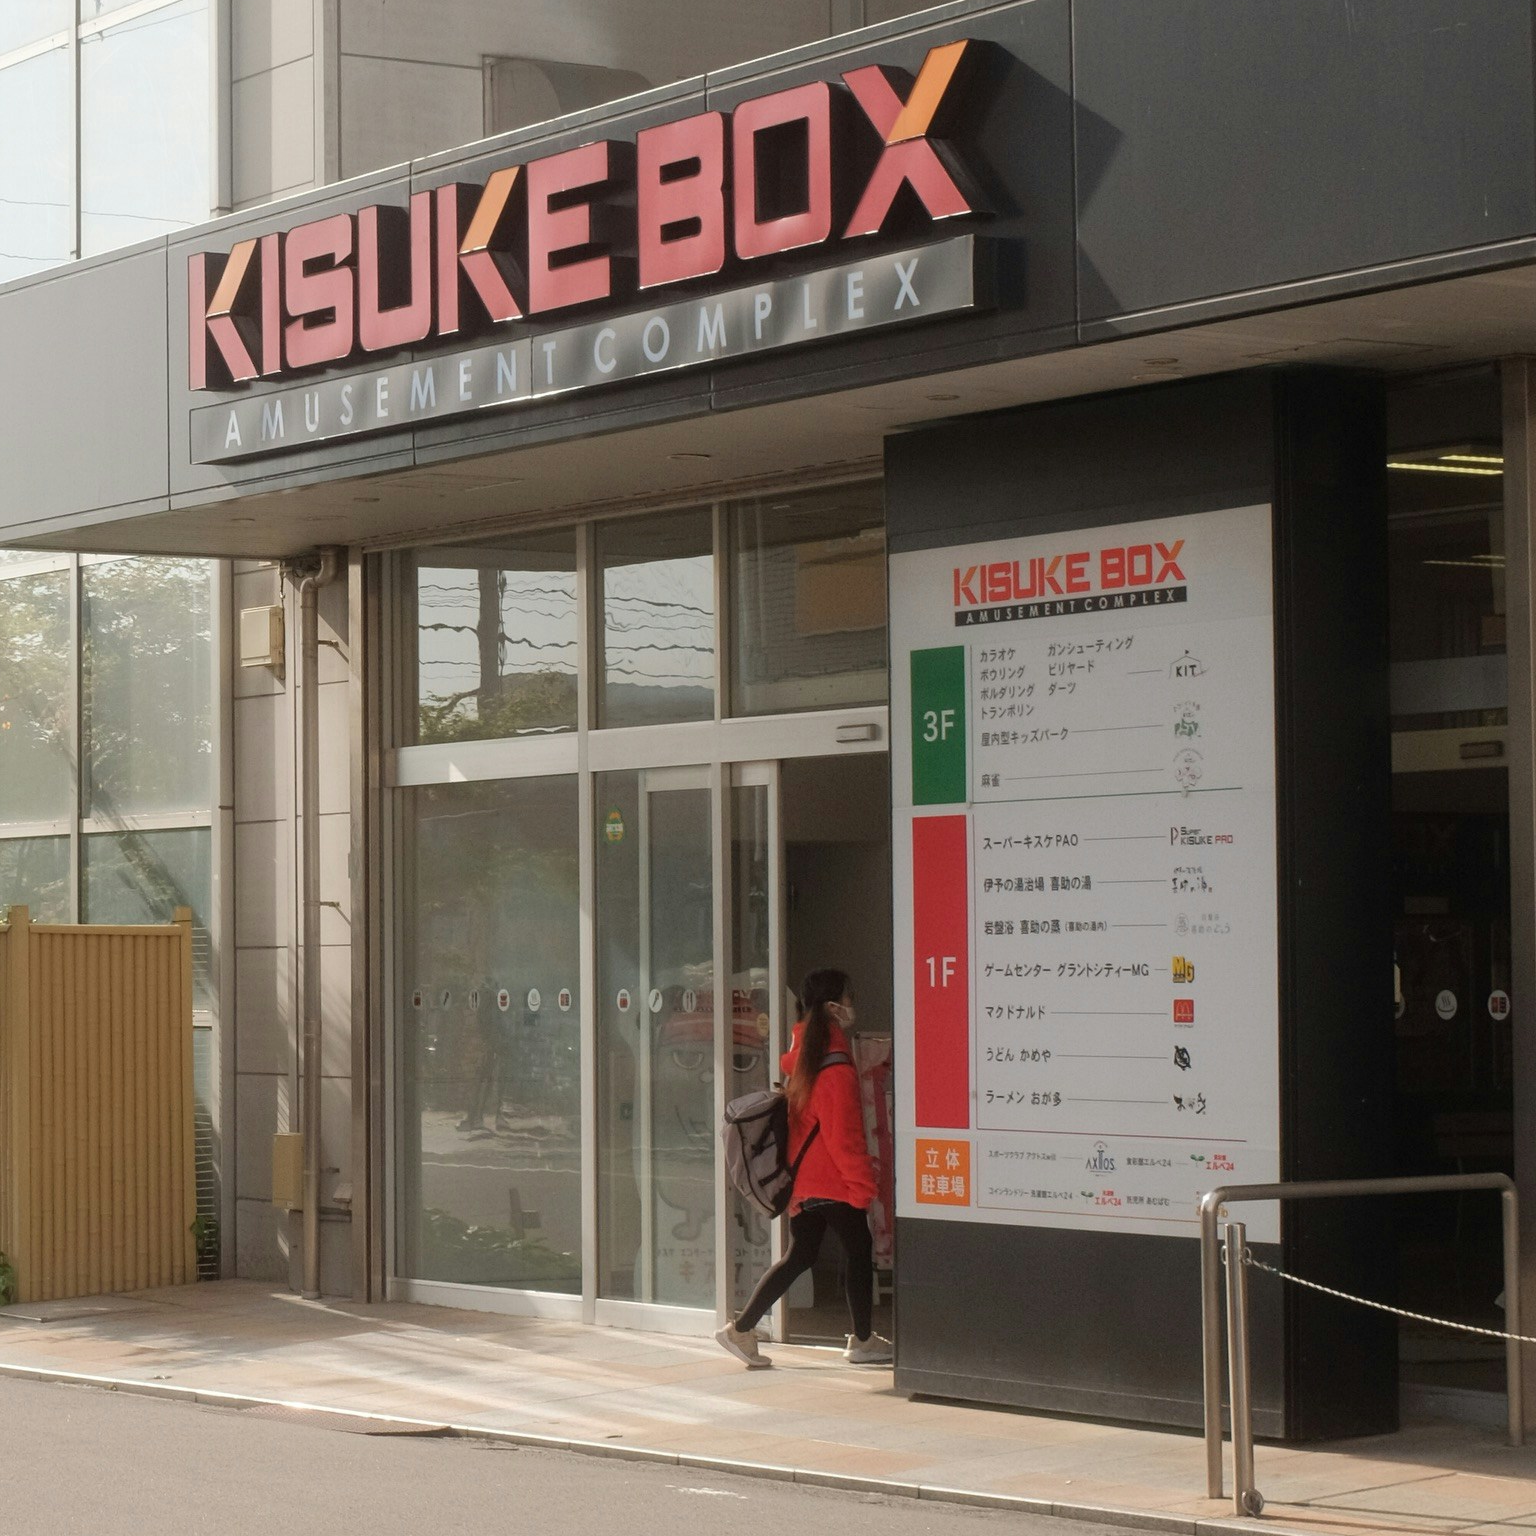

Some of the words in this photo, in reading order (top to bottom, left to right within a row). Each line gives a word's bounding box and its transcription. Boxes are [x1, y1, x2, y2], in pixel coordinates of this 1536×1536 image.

[187, 141, 611, 391] KISUKE
[636, 38, 972, 291] BOX
[225, 341, 556, 449] AMUSEMENT
[593, 258, 921, 374] COMPLEX
[953, 551, 1091, 606] KISUKE
[1100, 539, 1186, 590] BOX
[966, 602, 1075, 624] AMUSEMENT
[1084, 589, 1175, 611] COMPLEX
[980, 648, 1016, 663] カラオケ
[1047, 635, 1134, 656] ガンシューティング
[980, 666, 1026, 682] ボウリング
[1048, 659, 1095, 676] ビリヤード
[1175, 665, 1197, 678] KIT
[1048, 682, 1076, 696] ダーツ
[923, 709, 955, 742] 3F
[981, 728, 1069, 747] 屋内型キッズパーク
[983, 876, 1045, 893] 伊予の湯治場
[1049, 875, 1092, 892] 喜助の湯
[925, 955, 957, 989] 1F
[984, 963, 1051, 977] ゲームセンター
[985, 1005, 1046, 1020] マクドナルド
[986, 1047, 1014, 1062] うどん
[1020, 1048, 1051, 1062] かめや
[986, 1089, 1025, 1105] ラーメン
[925, 1147, 961, 1170] 立体
[921, 1174, 965, 1198] 駐車場
